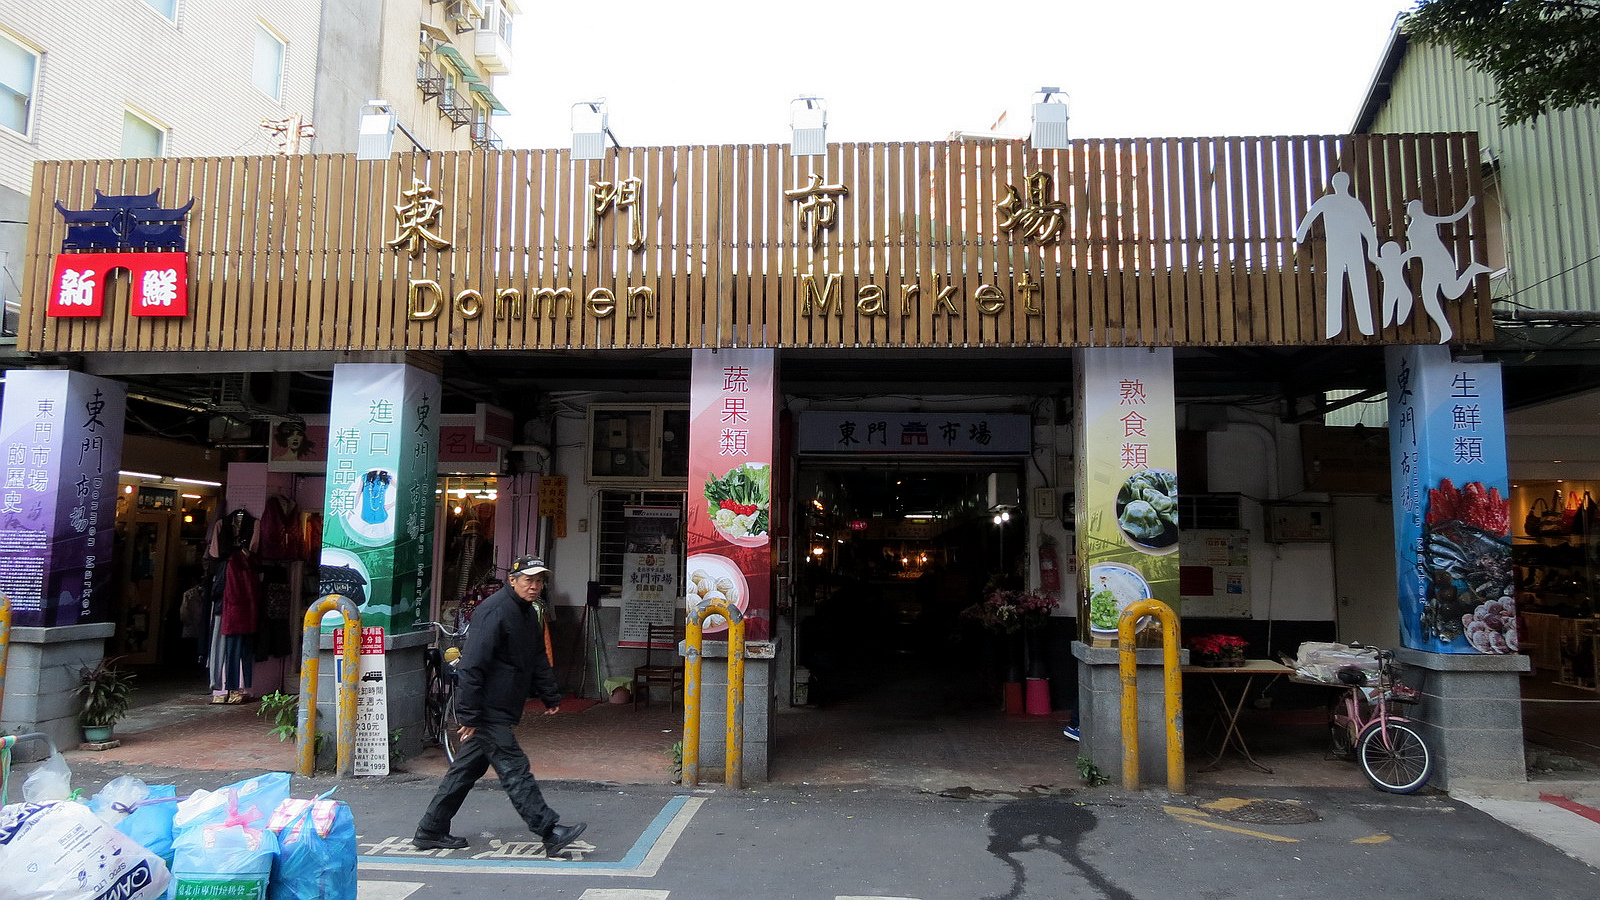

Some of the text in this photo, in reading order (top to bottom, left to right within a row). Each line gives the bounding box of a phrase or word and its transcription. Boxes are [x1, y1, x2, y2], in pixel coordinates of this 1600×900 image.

[387, 171, 1067, 257] 東門市場
[60, 269, 178, 306] 新鮮
[408, 273, 1041, 321] Donmen Market
[28, 398, 55, 492] 東門市場
[368, 399, 394, 455] 進口
[719, 365, 750, 457] 蔬果類
[1119, 378, 1149, 470] 熟食類
[1450, 371, 1484, 465] 生鮮類
[1, 443, 27, 513] 的歷史
[70, 388, 106, 533] 東門市場
[329, 427, 361, 516] 精品類
[81, 555, 95, 616] Market
[630, 572, 673, 585] 東門市場
